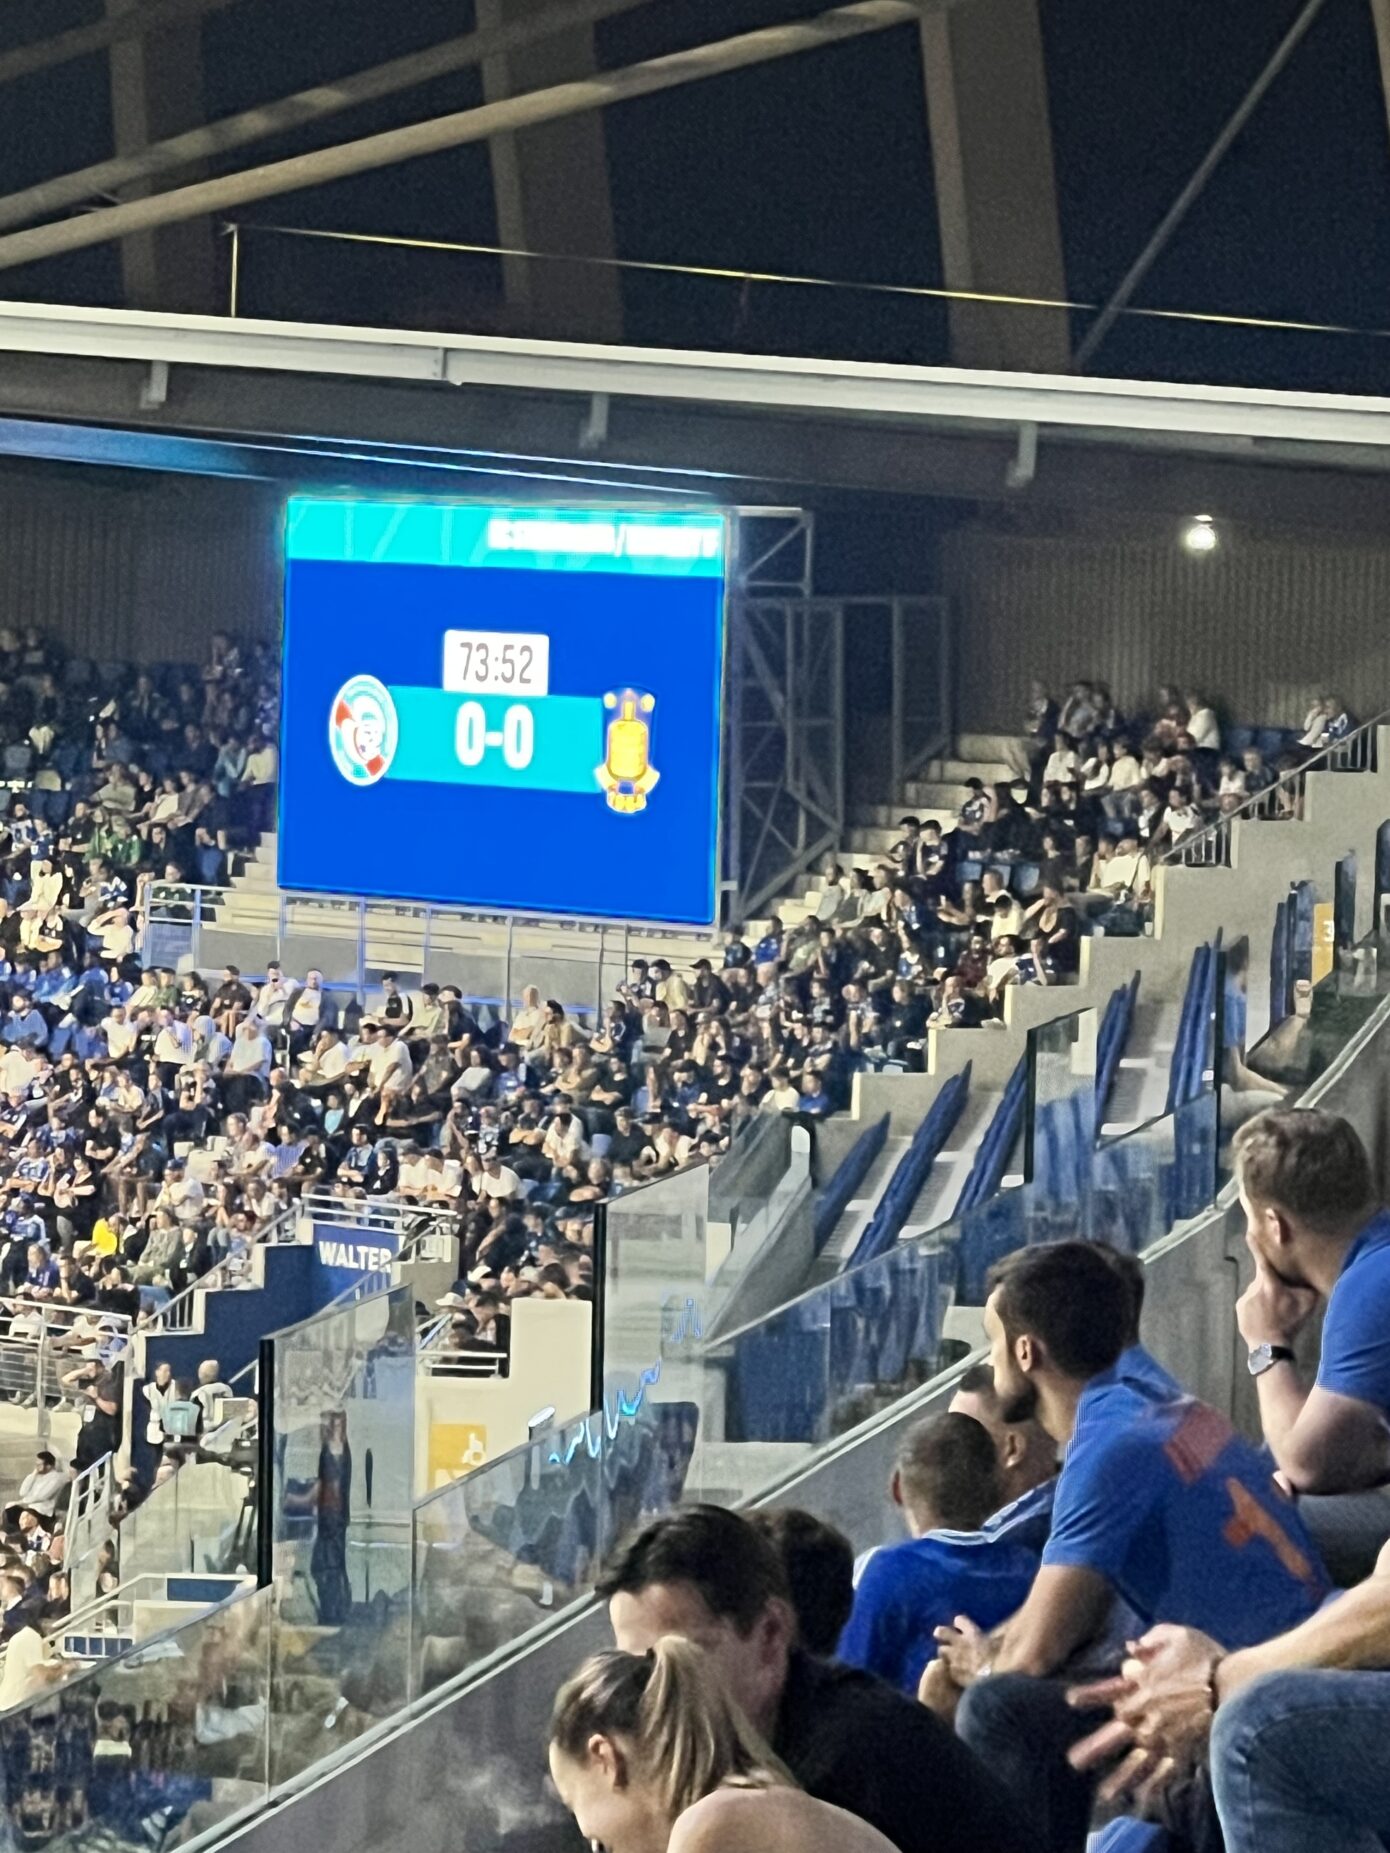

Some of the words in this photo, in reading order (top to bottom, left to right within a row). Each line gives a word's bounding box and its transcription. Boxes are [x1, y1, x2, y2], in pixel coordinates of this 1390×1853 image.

[460, 642, 533, 684] 73:52
[456, 701, 534, 769] 0-0
[318, 1240, 392, 1273] WALTER
